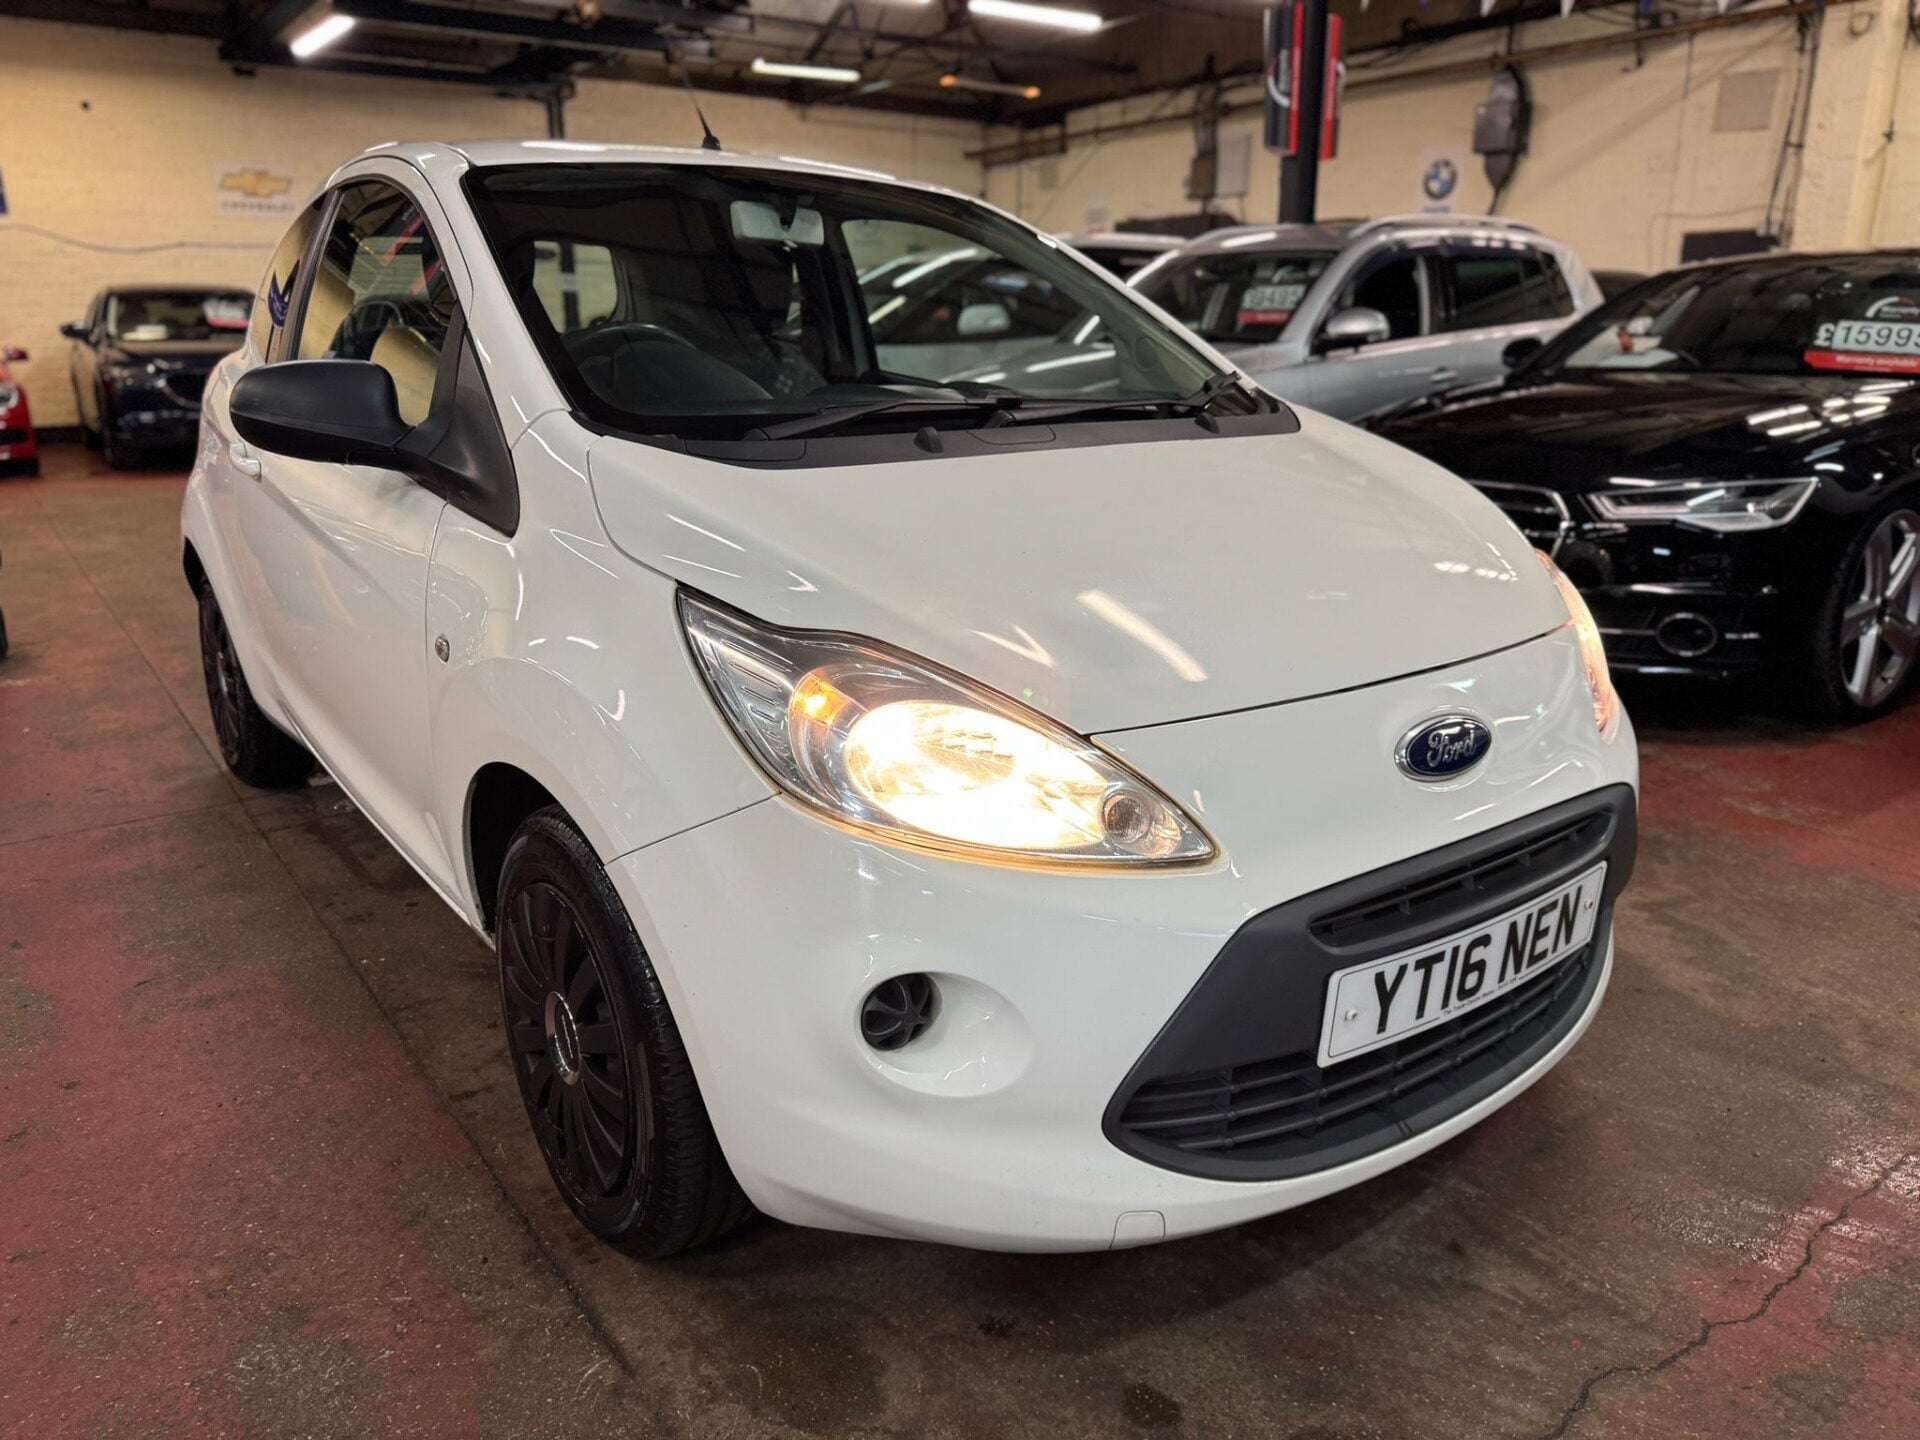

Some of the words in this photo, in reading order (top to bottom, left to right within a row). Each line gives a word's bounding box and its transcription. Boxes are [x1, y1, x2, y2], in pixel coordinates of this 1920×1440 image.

[1426, 726, 1478, 768] Ford
[1374, 933, 1492, 1035] YT16
[1497, 885, 1583, 985] NEN
